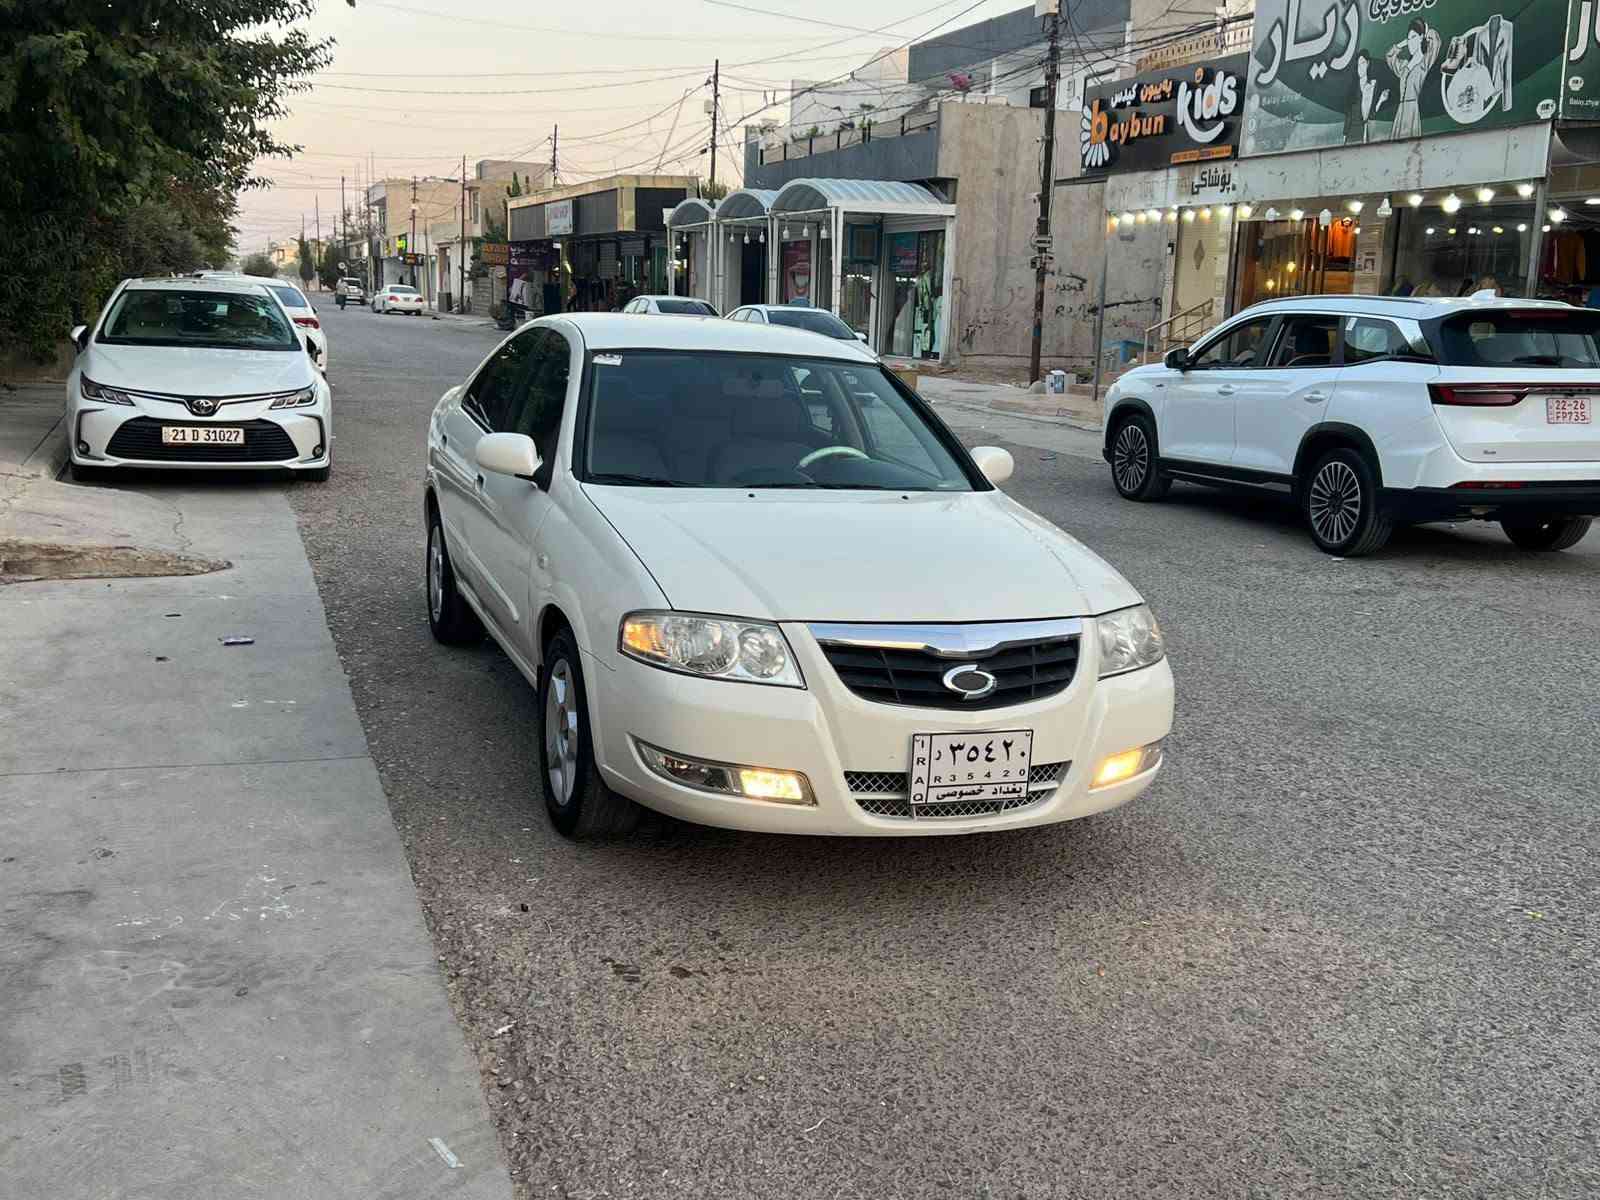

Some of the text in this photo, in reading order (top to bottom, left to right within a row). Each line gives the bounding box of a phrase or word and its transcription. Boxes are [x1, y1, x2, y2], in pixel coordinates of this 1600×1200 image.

[1091, 99, 1165, 145] baybun
[1555, 400, 1585, 410] 22-26
[172, 429, 240, 442] 21 D 31027
